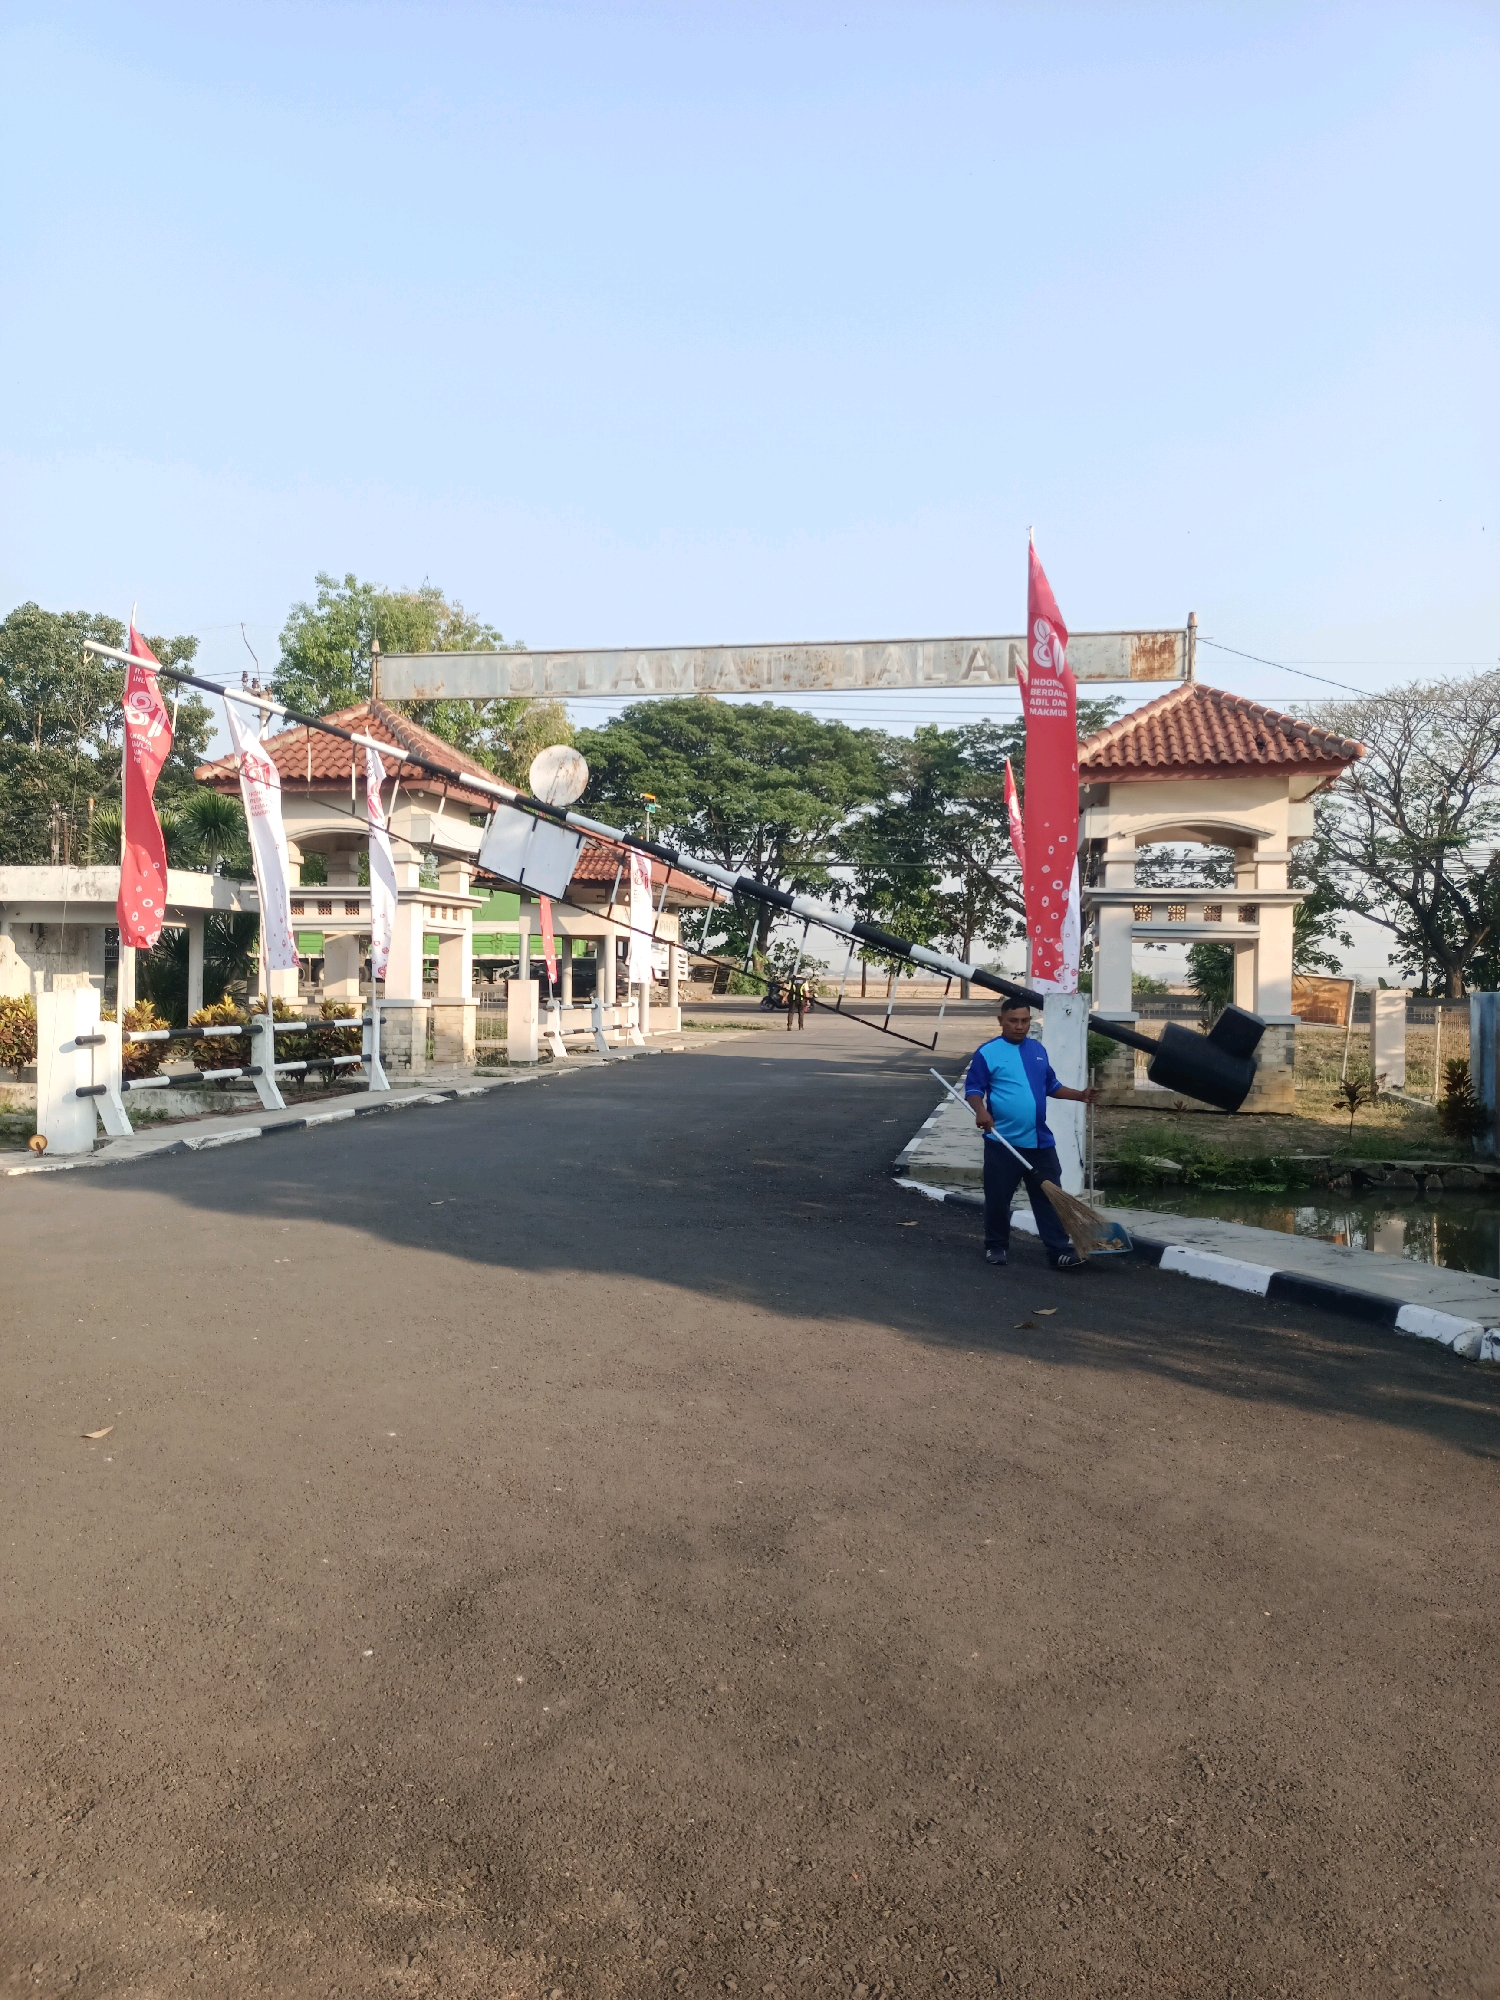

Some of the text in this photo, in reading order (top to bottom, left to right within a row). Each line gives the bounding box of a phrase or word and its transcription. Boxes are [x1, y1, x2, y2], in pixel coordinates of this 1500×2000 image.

[507, 651, 785, 692] SELAMAT
[1029, 698, 1050, 706] ADIL
[1029, 708, 1068, 717] MAKMUR
